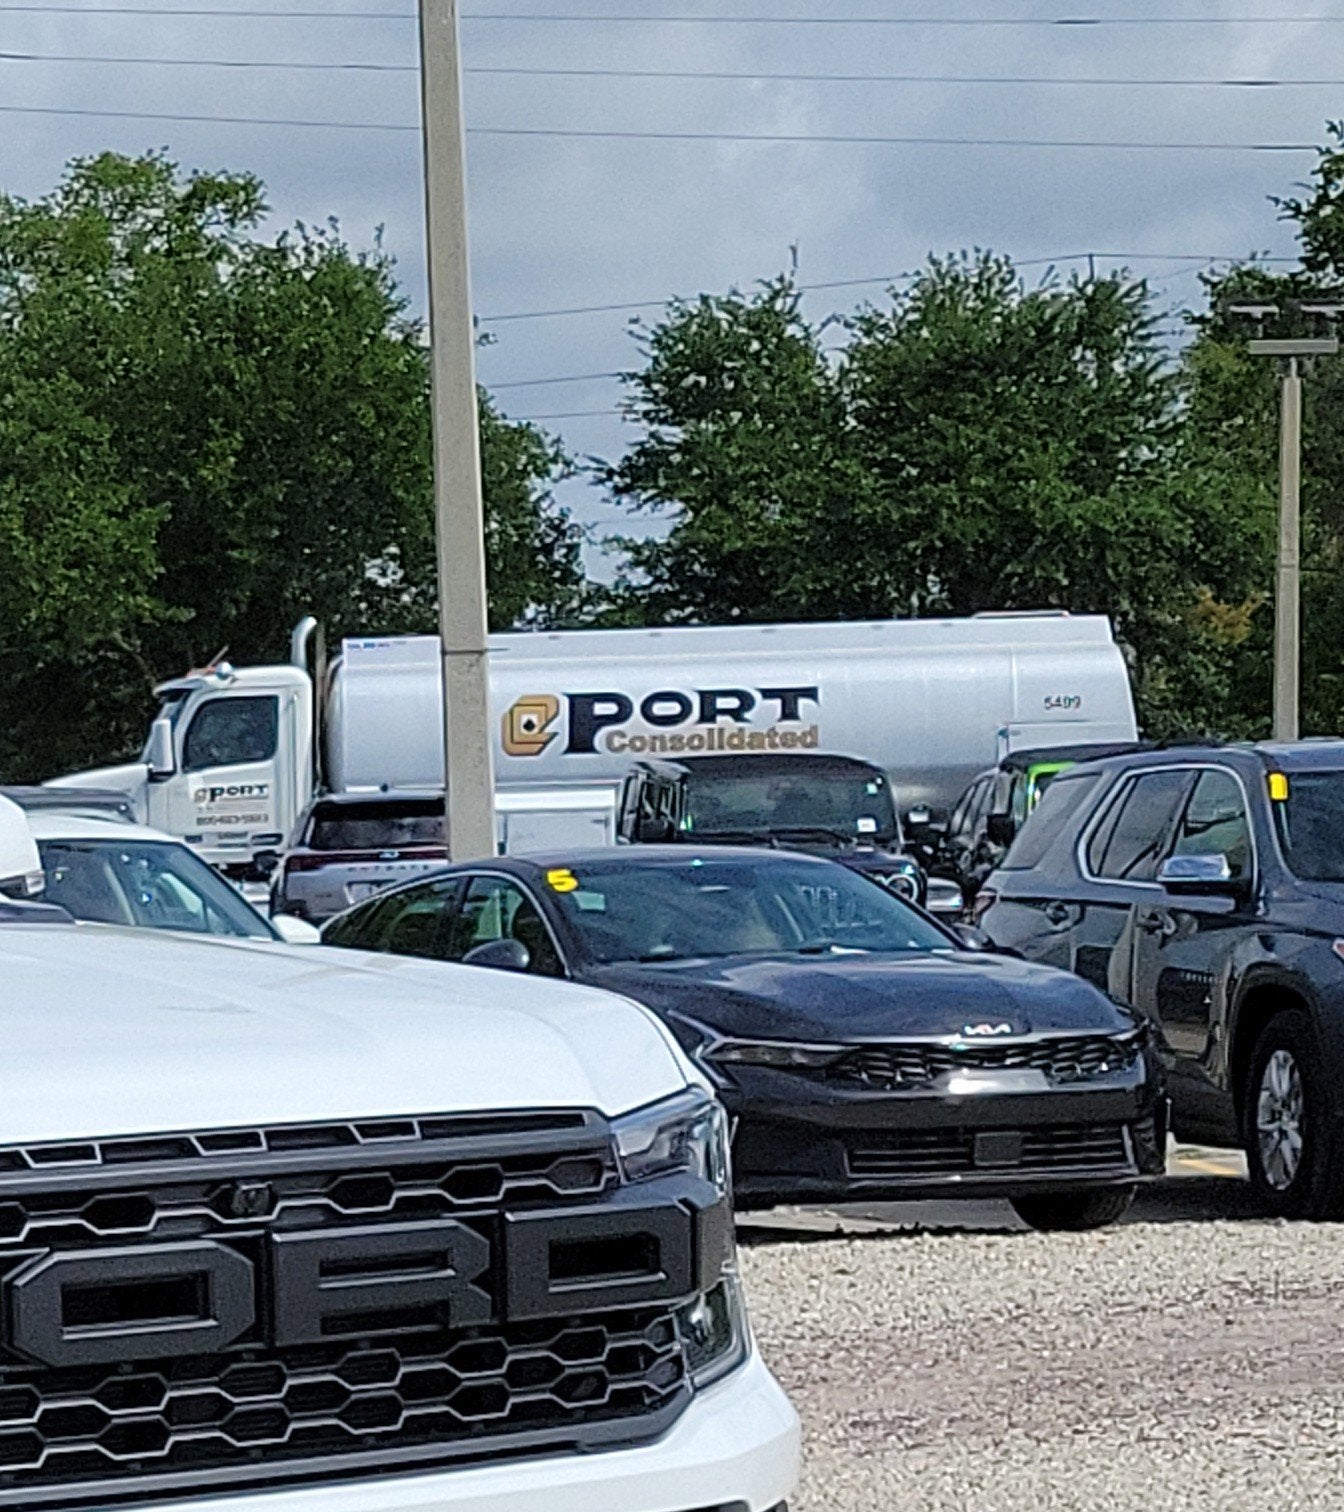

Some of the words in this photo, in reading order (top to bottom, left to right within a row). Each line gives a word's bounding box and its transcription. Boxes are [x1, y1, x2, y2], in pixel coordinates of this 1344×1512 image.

[563, 687, 820, 754] PORT
[606, 725, 820, 754] Consolidated
[209, 784, 269, 802] PORT
[547, 869, 578, 892] 5
